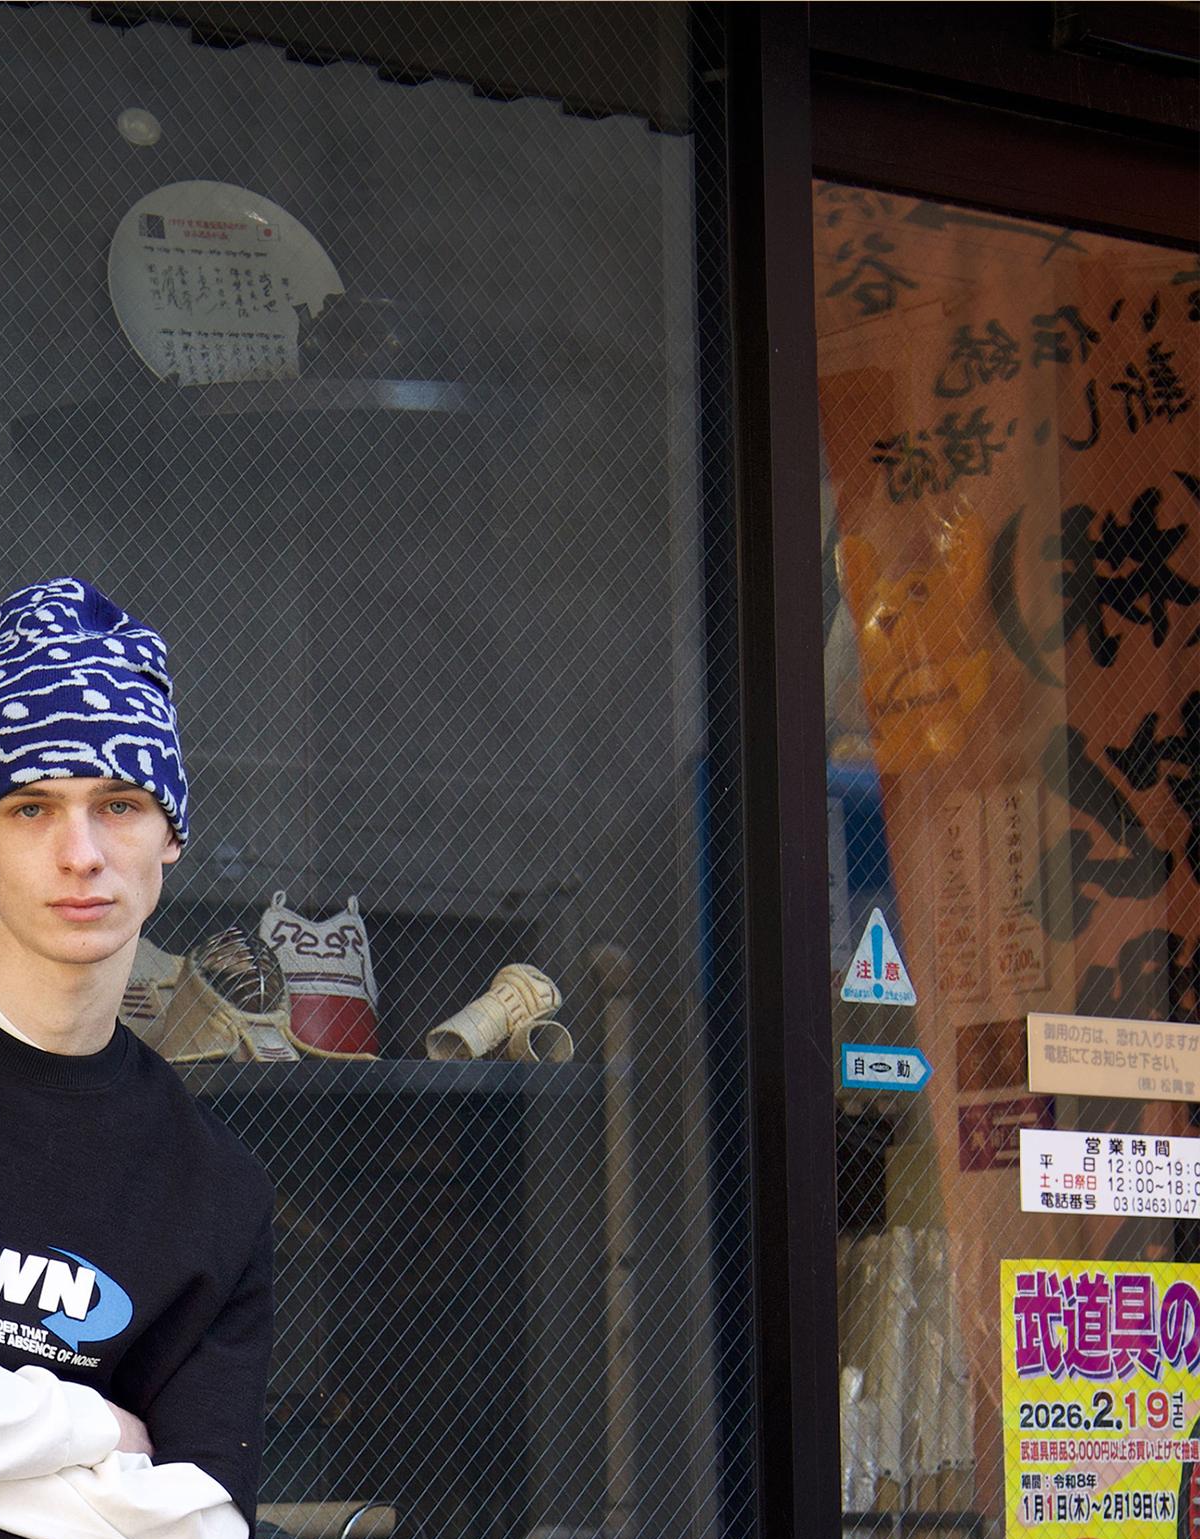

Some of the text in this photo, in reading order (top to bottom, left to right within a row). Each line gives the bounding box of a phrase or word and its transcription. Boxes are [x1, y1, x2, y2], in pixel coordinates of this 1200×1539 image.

[855, 959, 901, 982] 注 意
[854, 1056, 865, 1076] 自
[1044, 1045, 1180, 1075] 電話にてお知らせ下さい。
[1085, 1137, 1171, 1158] 営業時間
[1040, 1192, 1097, 1211] 電話番号
[19, 1323, 49, 1343] THAT
[1014, 1270, 1200, 1383] 武道具の
[6, 1333, 57, 1360] ABSENCE
[58, 1349, 72, 1363] OF
[71, 1353, 102, 1369] NOISE
[1019, 1391, 1184, 1431] 2026.2.19 THU
